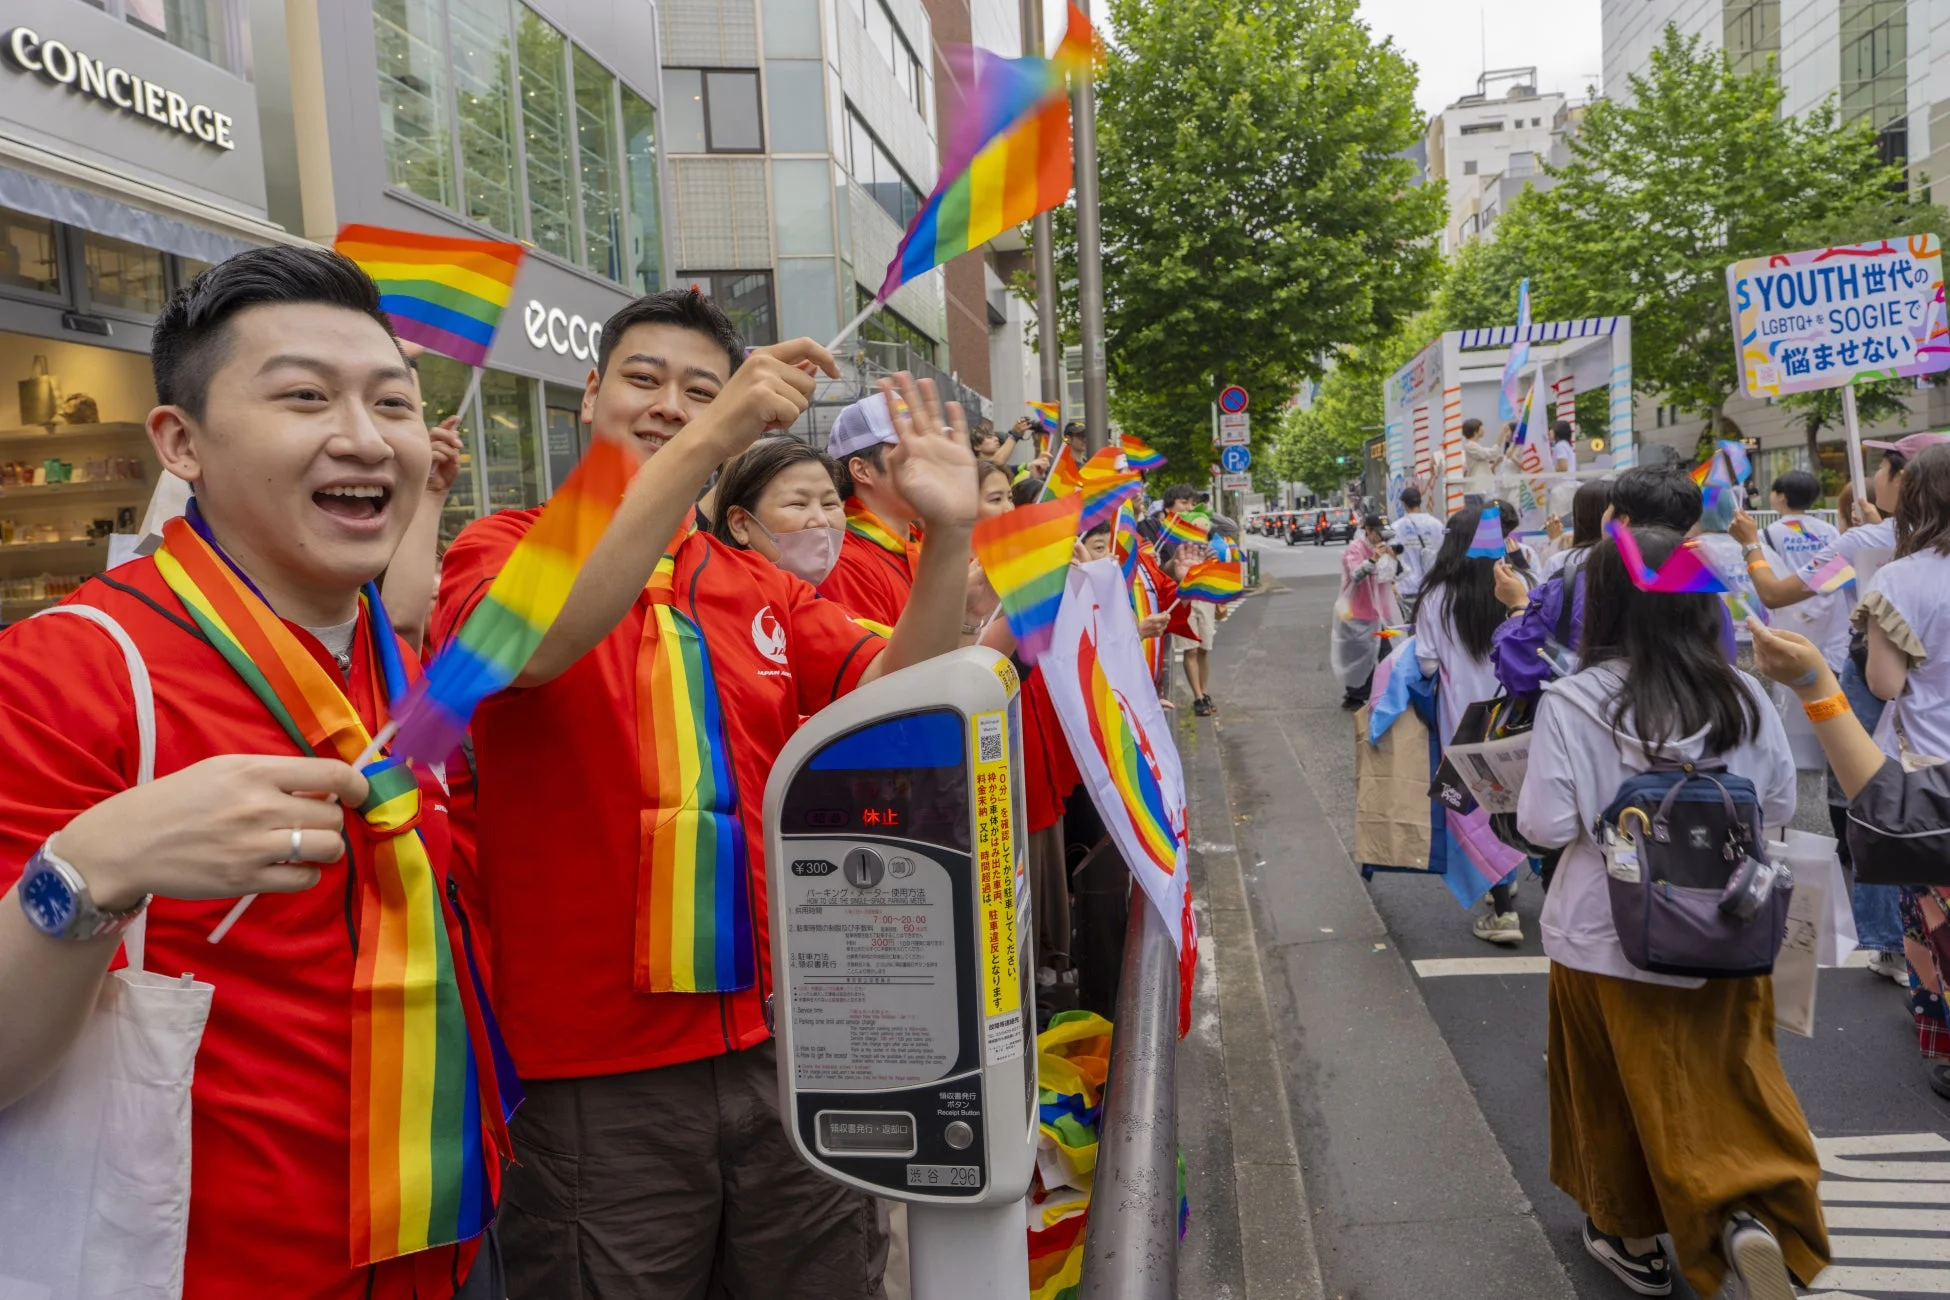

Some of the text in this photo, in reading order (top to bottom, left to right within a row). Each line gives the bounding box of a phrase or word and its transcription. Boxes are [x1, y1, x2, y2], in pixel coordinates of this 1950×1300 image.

[11, 26, 235, 150] CONCIERGE
[1781, 335, 1912, 377] 悩ませない
[862, 807, 899, 827] 休止
[795, 862, 828, 874] ¥300
[939, 1092, 977, 1101] 領収書発行
[947, 1101, 970, 1109] ボタン
[937, 1109, 960, 1117] Receipt
[950, 1167, 977, 1186] 296
